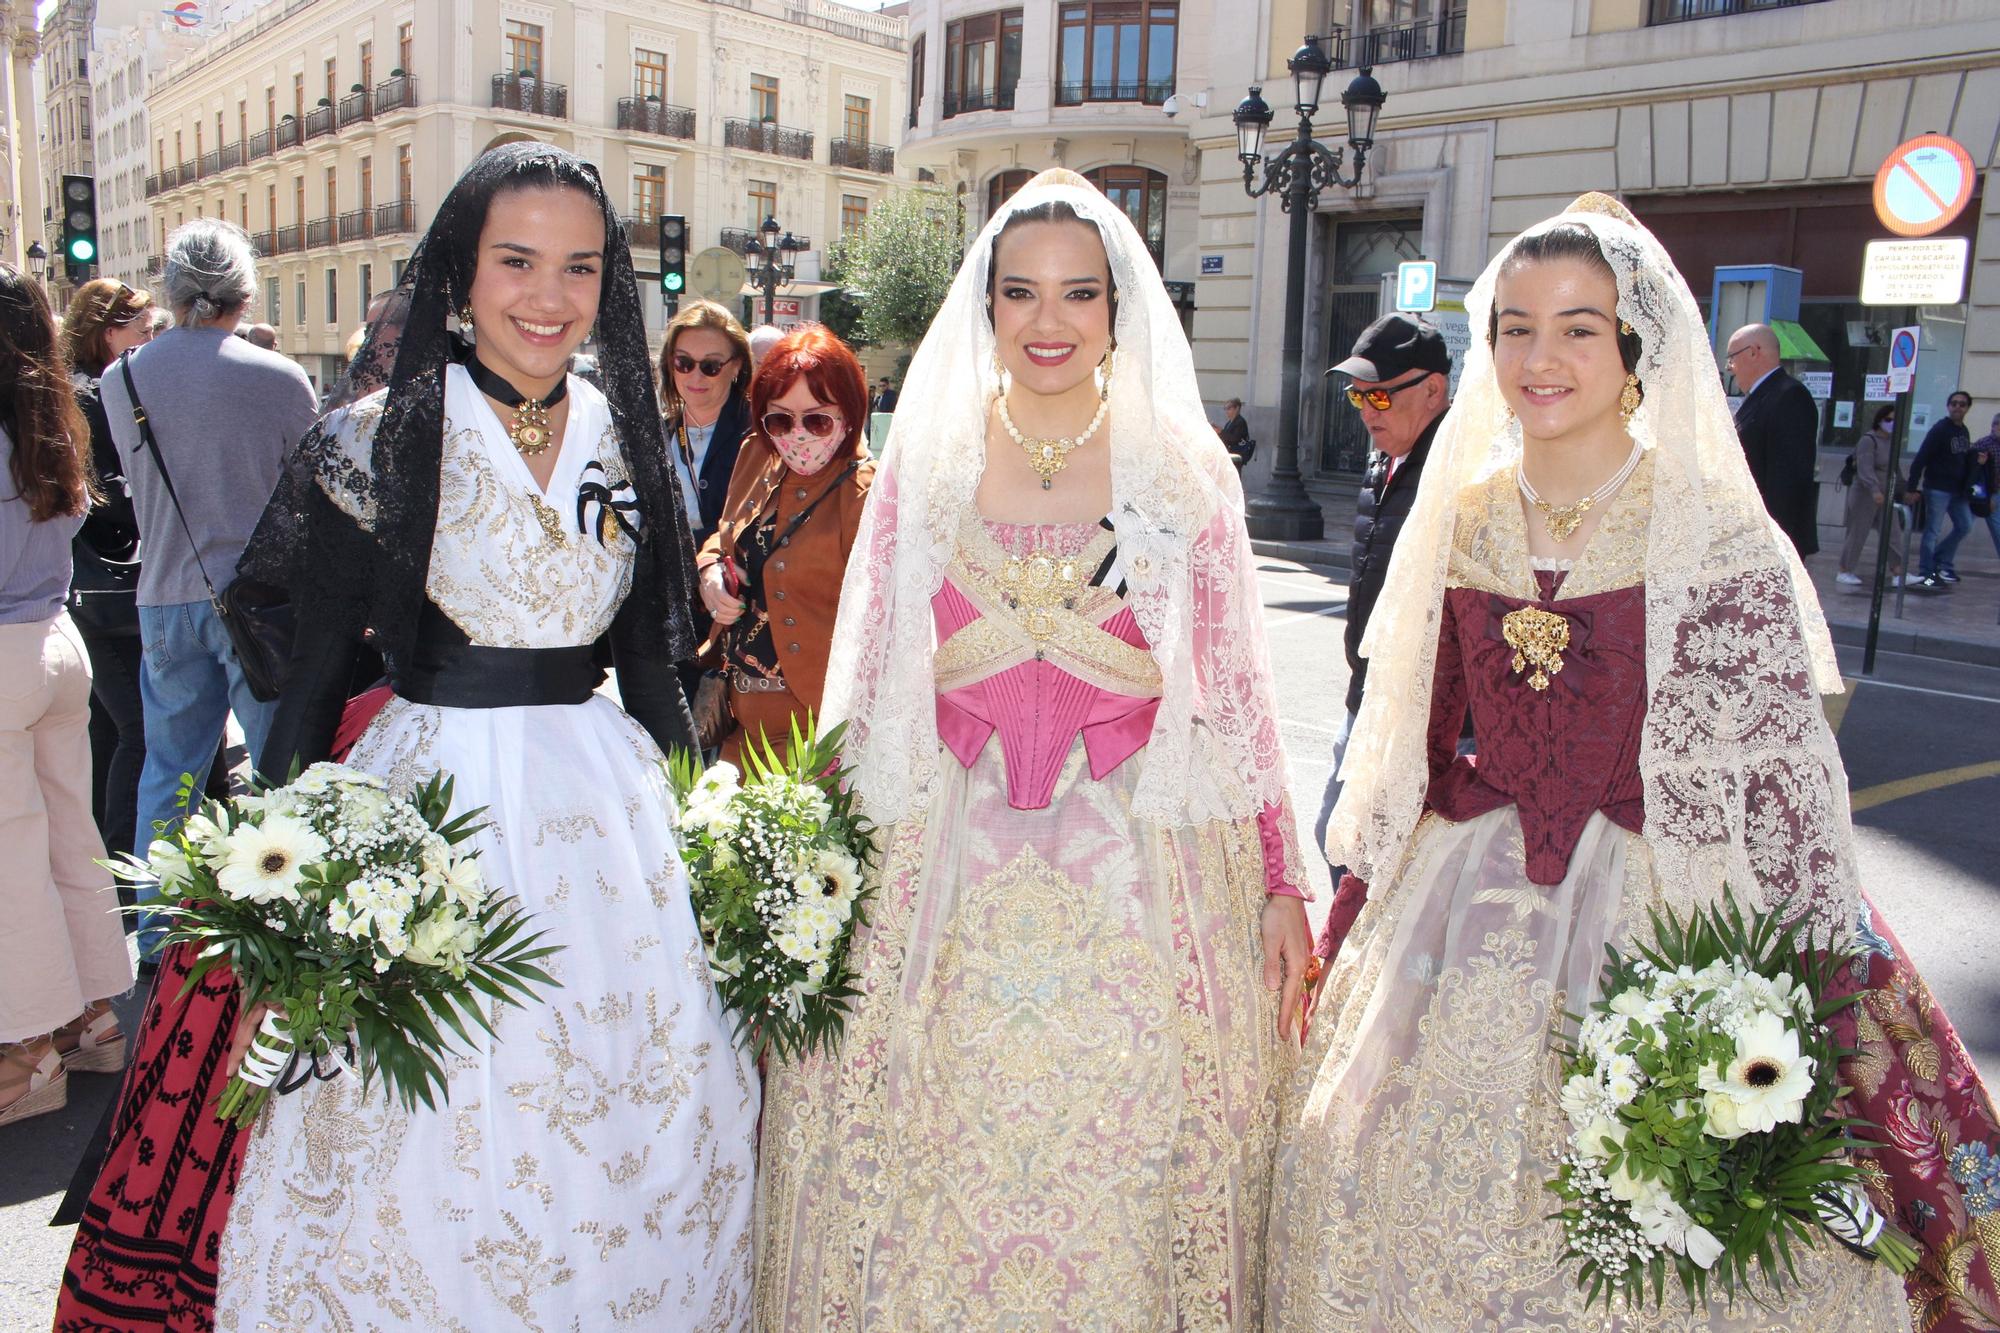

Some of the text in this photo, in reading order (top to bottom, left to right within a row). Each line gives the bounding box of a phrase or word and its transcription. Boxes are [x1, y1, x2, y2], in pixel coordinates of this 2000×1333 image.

[1911, 254, 1956, 262] DESCARGA
[1405, 267, 1428, 305] P
[773, 301, 797, 312] KFC
